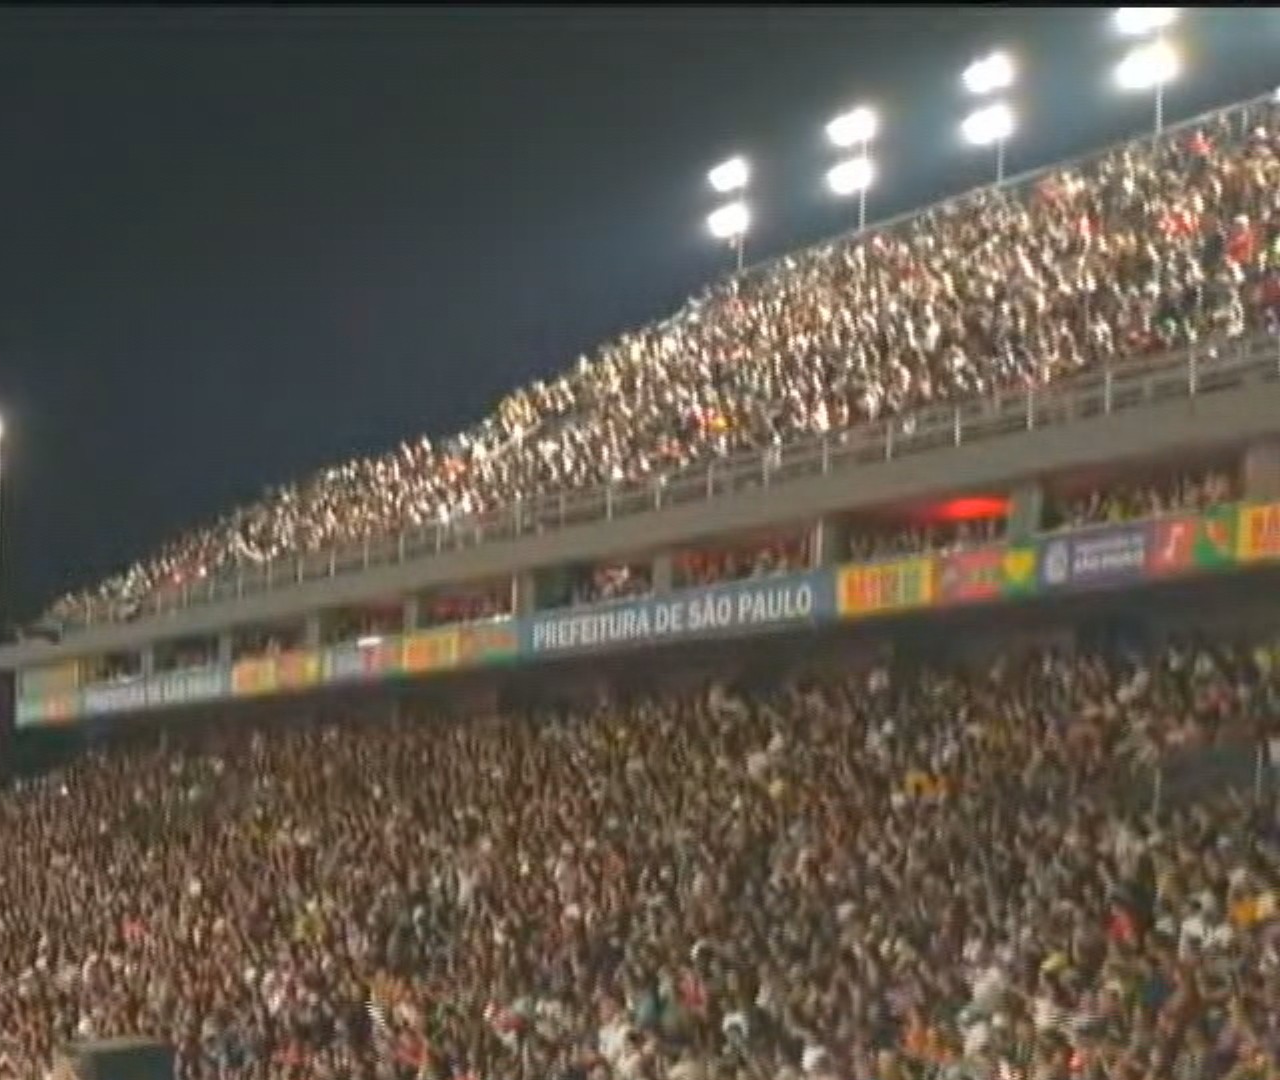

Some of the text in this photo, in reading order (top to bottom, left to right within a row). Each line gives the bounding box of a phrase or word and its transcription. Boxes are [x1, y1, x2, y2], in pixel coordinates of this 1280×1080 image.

[655, 601, 686, 632] DE
[688, 592, 732, 629] SÃO
[739, 583, 813, 622] PAULO
